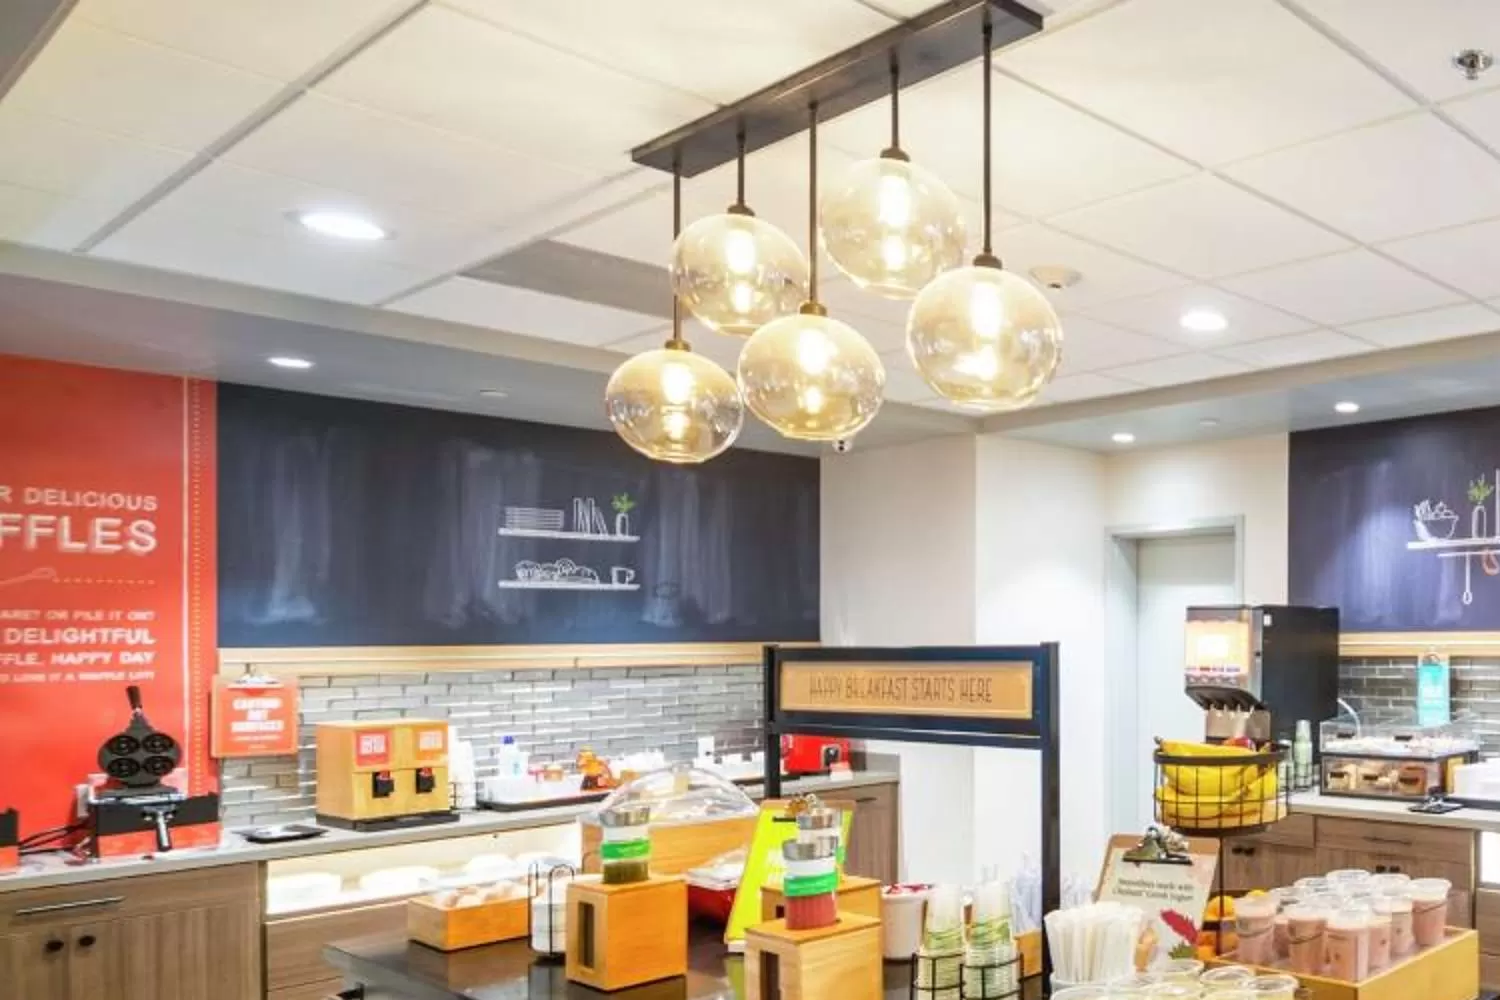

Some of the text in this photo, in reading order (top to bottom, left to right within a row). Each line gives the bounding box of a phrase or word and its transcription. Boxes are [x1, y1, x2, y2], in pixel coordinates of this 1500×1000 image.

[24, 487, 158, 512] DELICIOUS
[4, 627, 157, 645] DELIGHTFUL
[51, 651, 113, 666] HAPPY
[118, 651, 156, 665] DAY
[845, 675, 909, 701] BREAKFAST
[911, 676, 956, 703] STARTS
[959, 676, 994, 704] HERE
